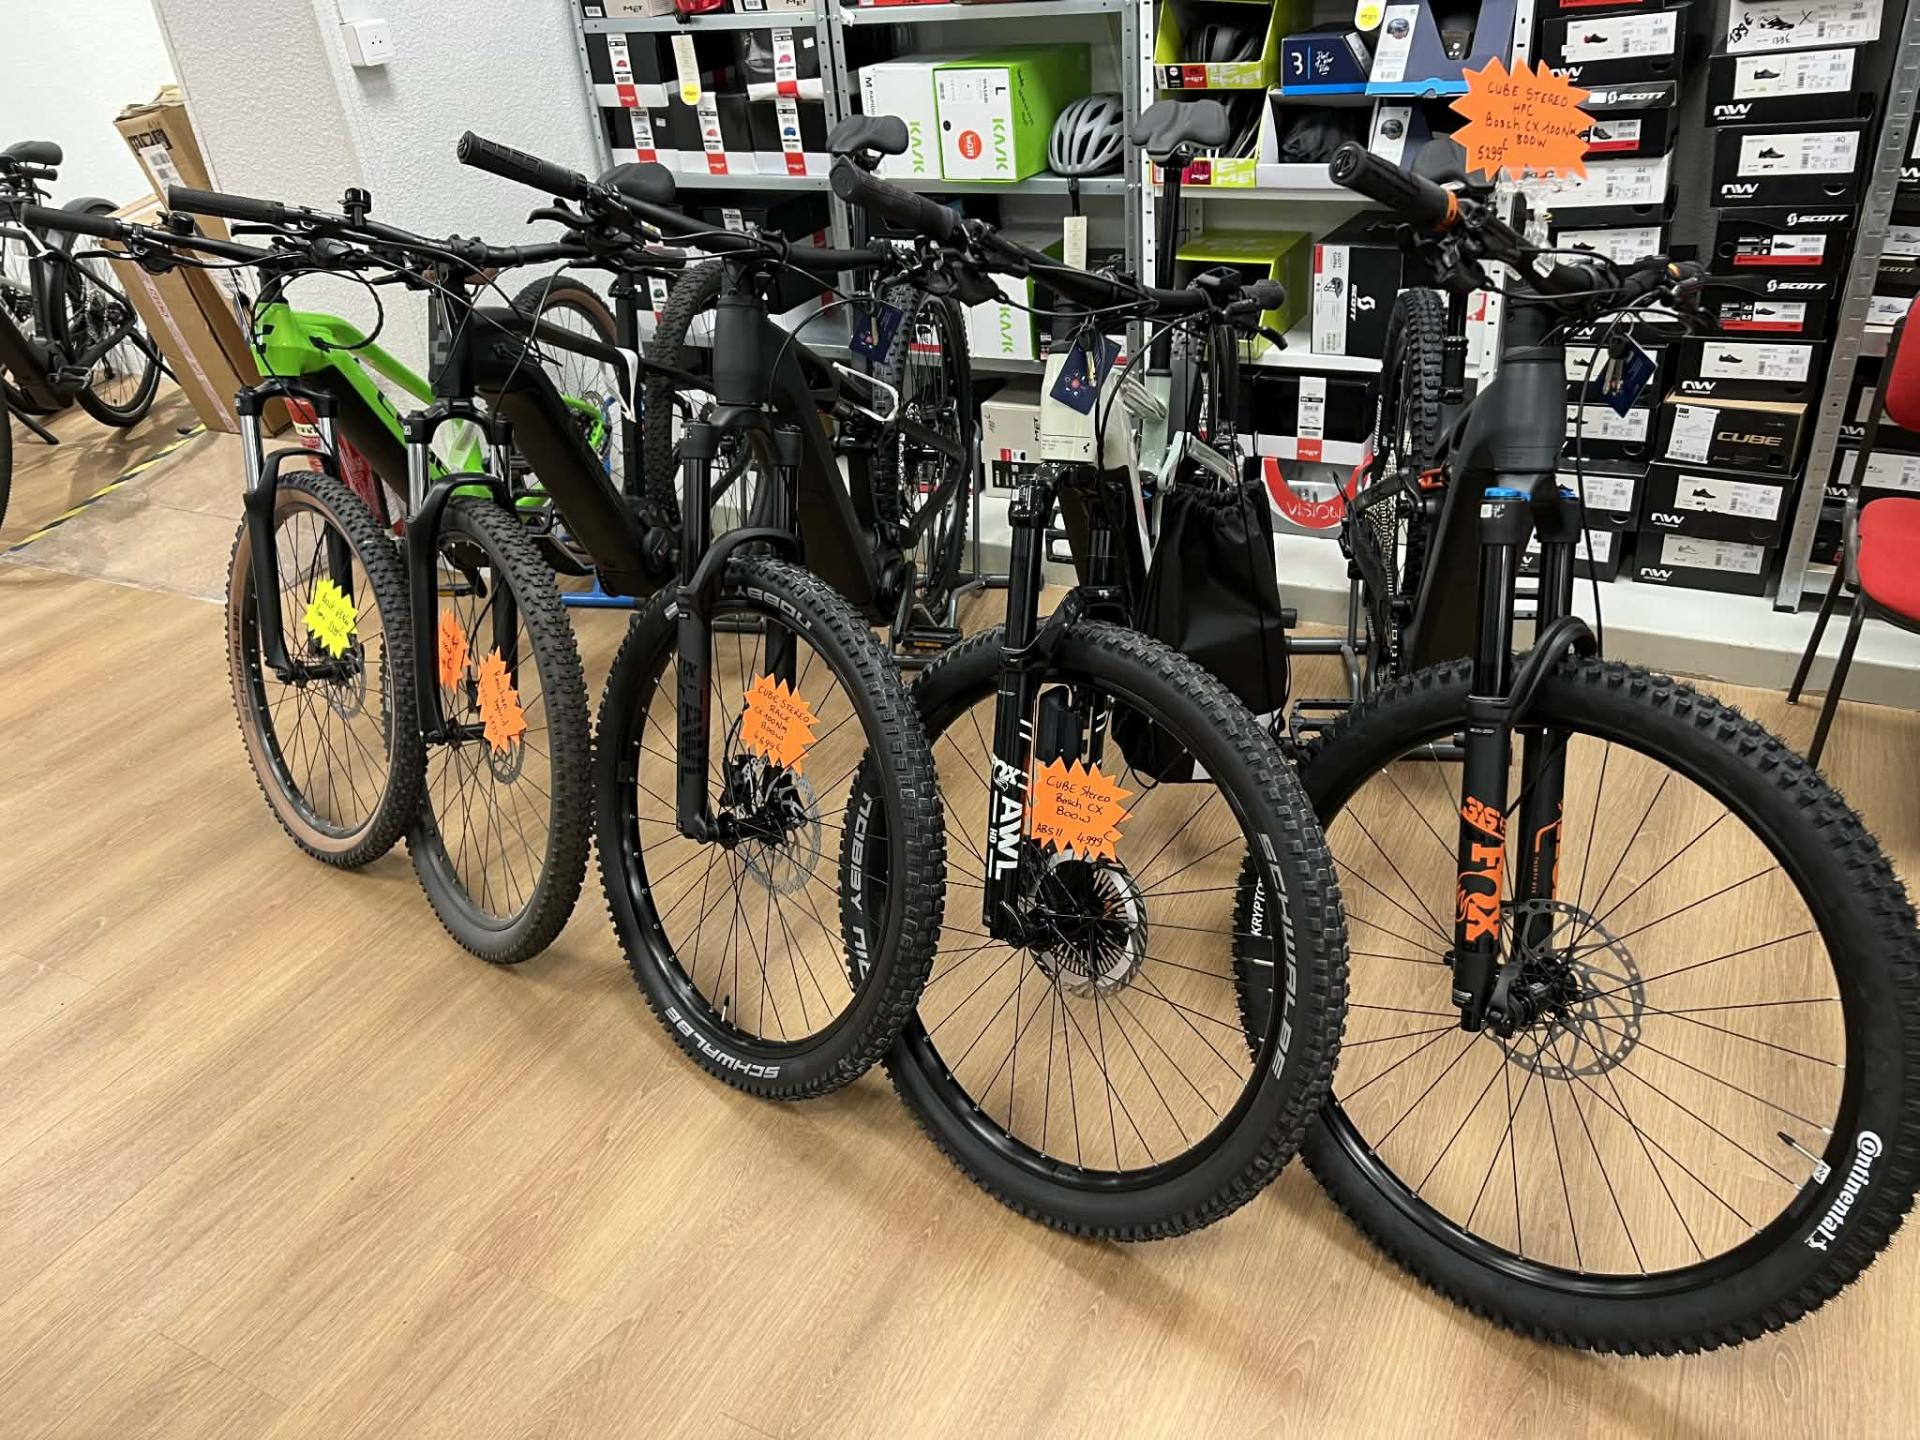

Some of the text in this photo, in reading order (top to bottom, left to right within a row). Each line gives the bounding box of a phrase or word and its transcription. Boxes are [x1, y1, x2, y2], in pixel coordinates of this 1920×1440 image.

[995, 86, 1006, 95] L
[1488, 82, 1519, 97] CUBE
[1618, 92, 1666, 100] SCOTT
[909, 121, 926, 174] KASK
[992, 118, 1009, 171] KASK
[1798, 214, 1849, 223] SCOTT
[999, 307, 1014, 353] KASK
[1717, 431, 1783, 446] CUBE
[1047, 776, 1077, 792] CUBE
[1087, 803, 1103, 815] CX
[989, 827, 998, 844] HD
[995, 796, 1023, 880] AWL
[1035, 823, 1054, 836] ABS
[850, 792, 873, 912] NOBBY
[1456, 843, 1505, 942] FOX
[1257, 833, 1297, 1080] SCHWALBE
[665, 1006, 781, 1079] SCHWALBE
[1817, 1130, 1883, 1242] Continental
